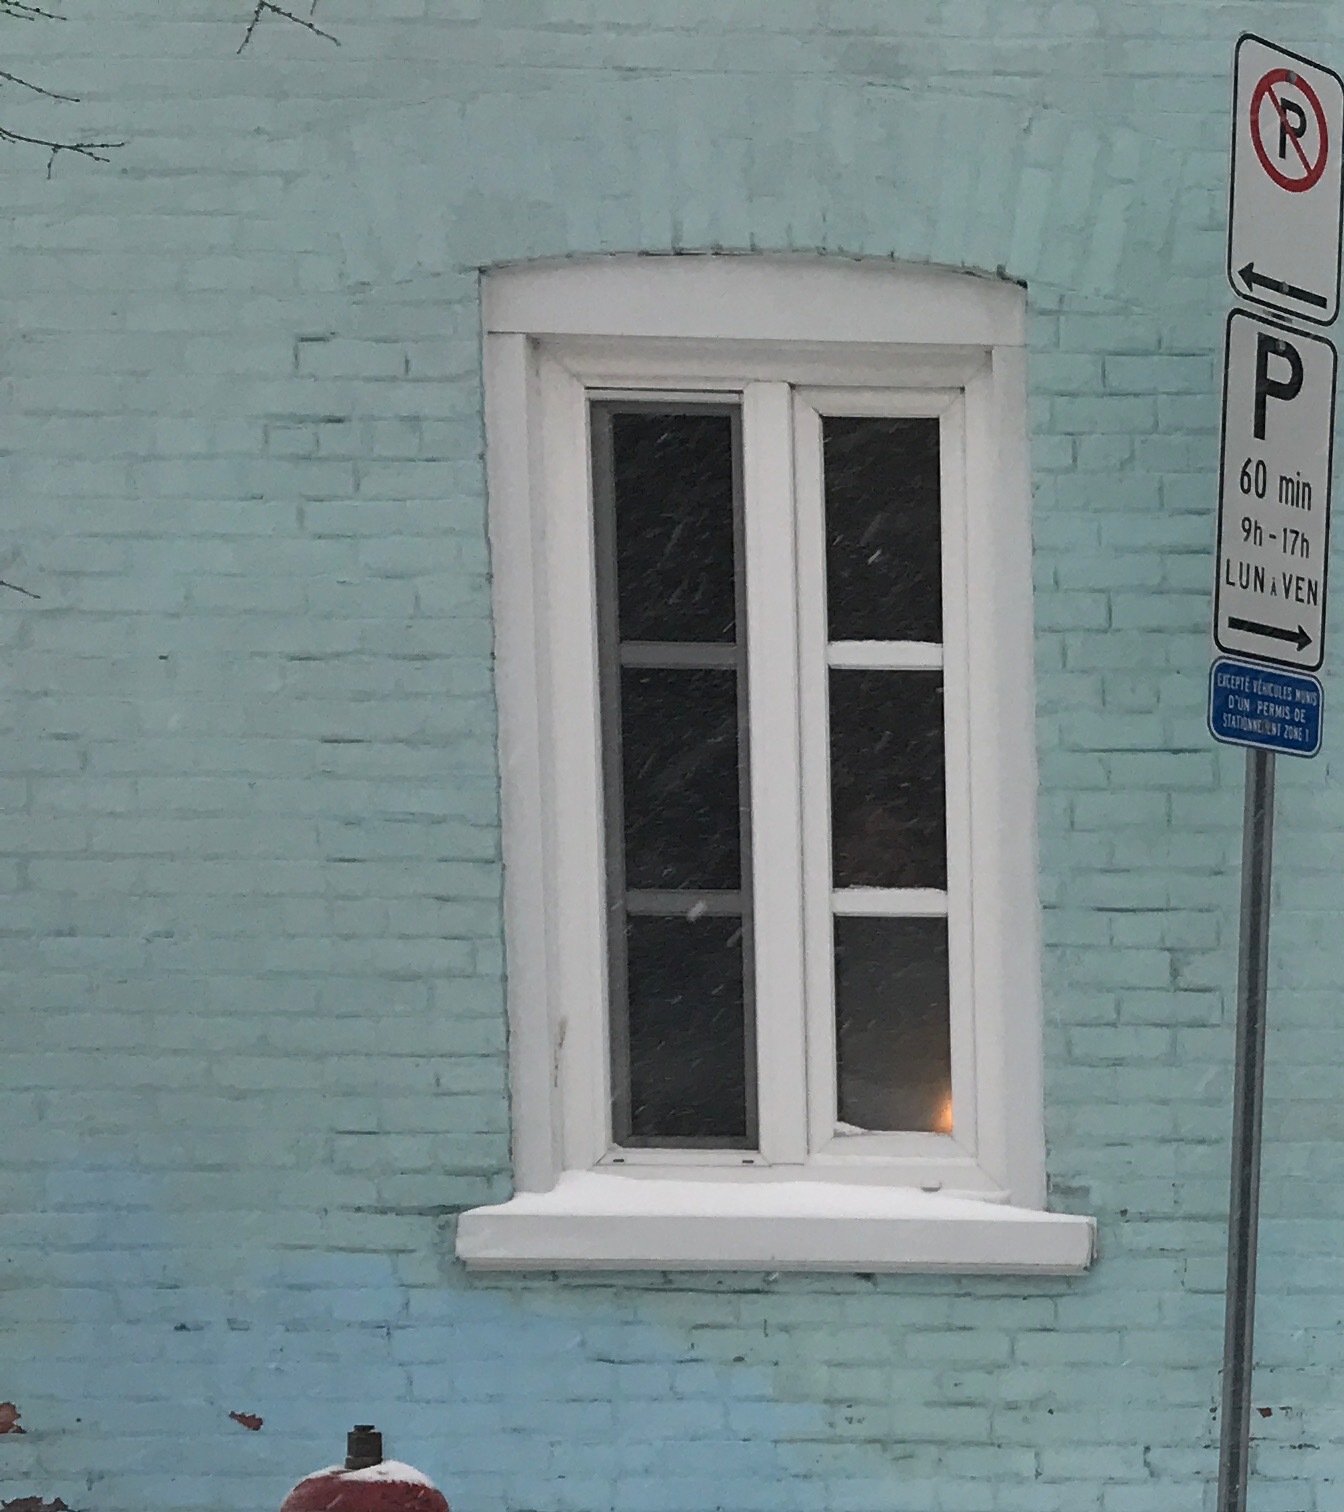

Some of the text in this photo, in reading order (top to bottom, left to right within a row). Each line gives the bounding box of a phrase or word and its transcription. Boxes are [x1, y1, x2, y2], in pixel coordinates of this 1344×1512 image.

[1279, 97, 1307, 160] P
[1253, 332, 1304, 441] P
[1239, 457, 1312, 511] 60 min
[1225, 558, 1265, 594] LUN
[1282, 572, 1319, 606] VEN
[1217, 673, 1250, 692] EXCEPTÉ
[1228, 694, 1306, 723] D'UN PERMIS DE
[1283, 724, 1303, 741] ZONE
